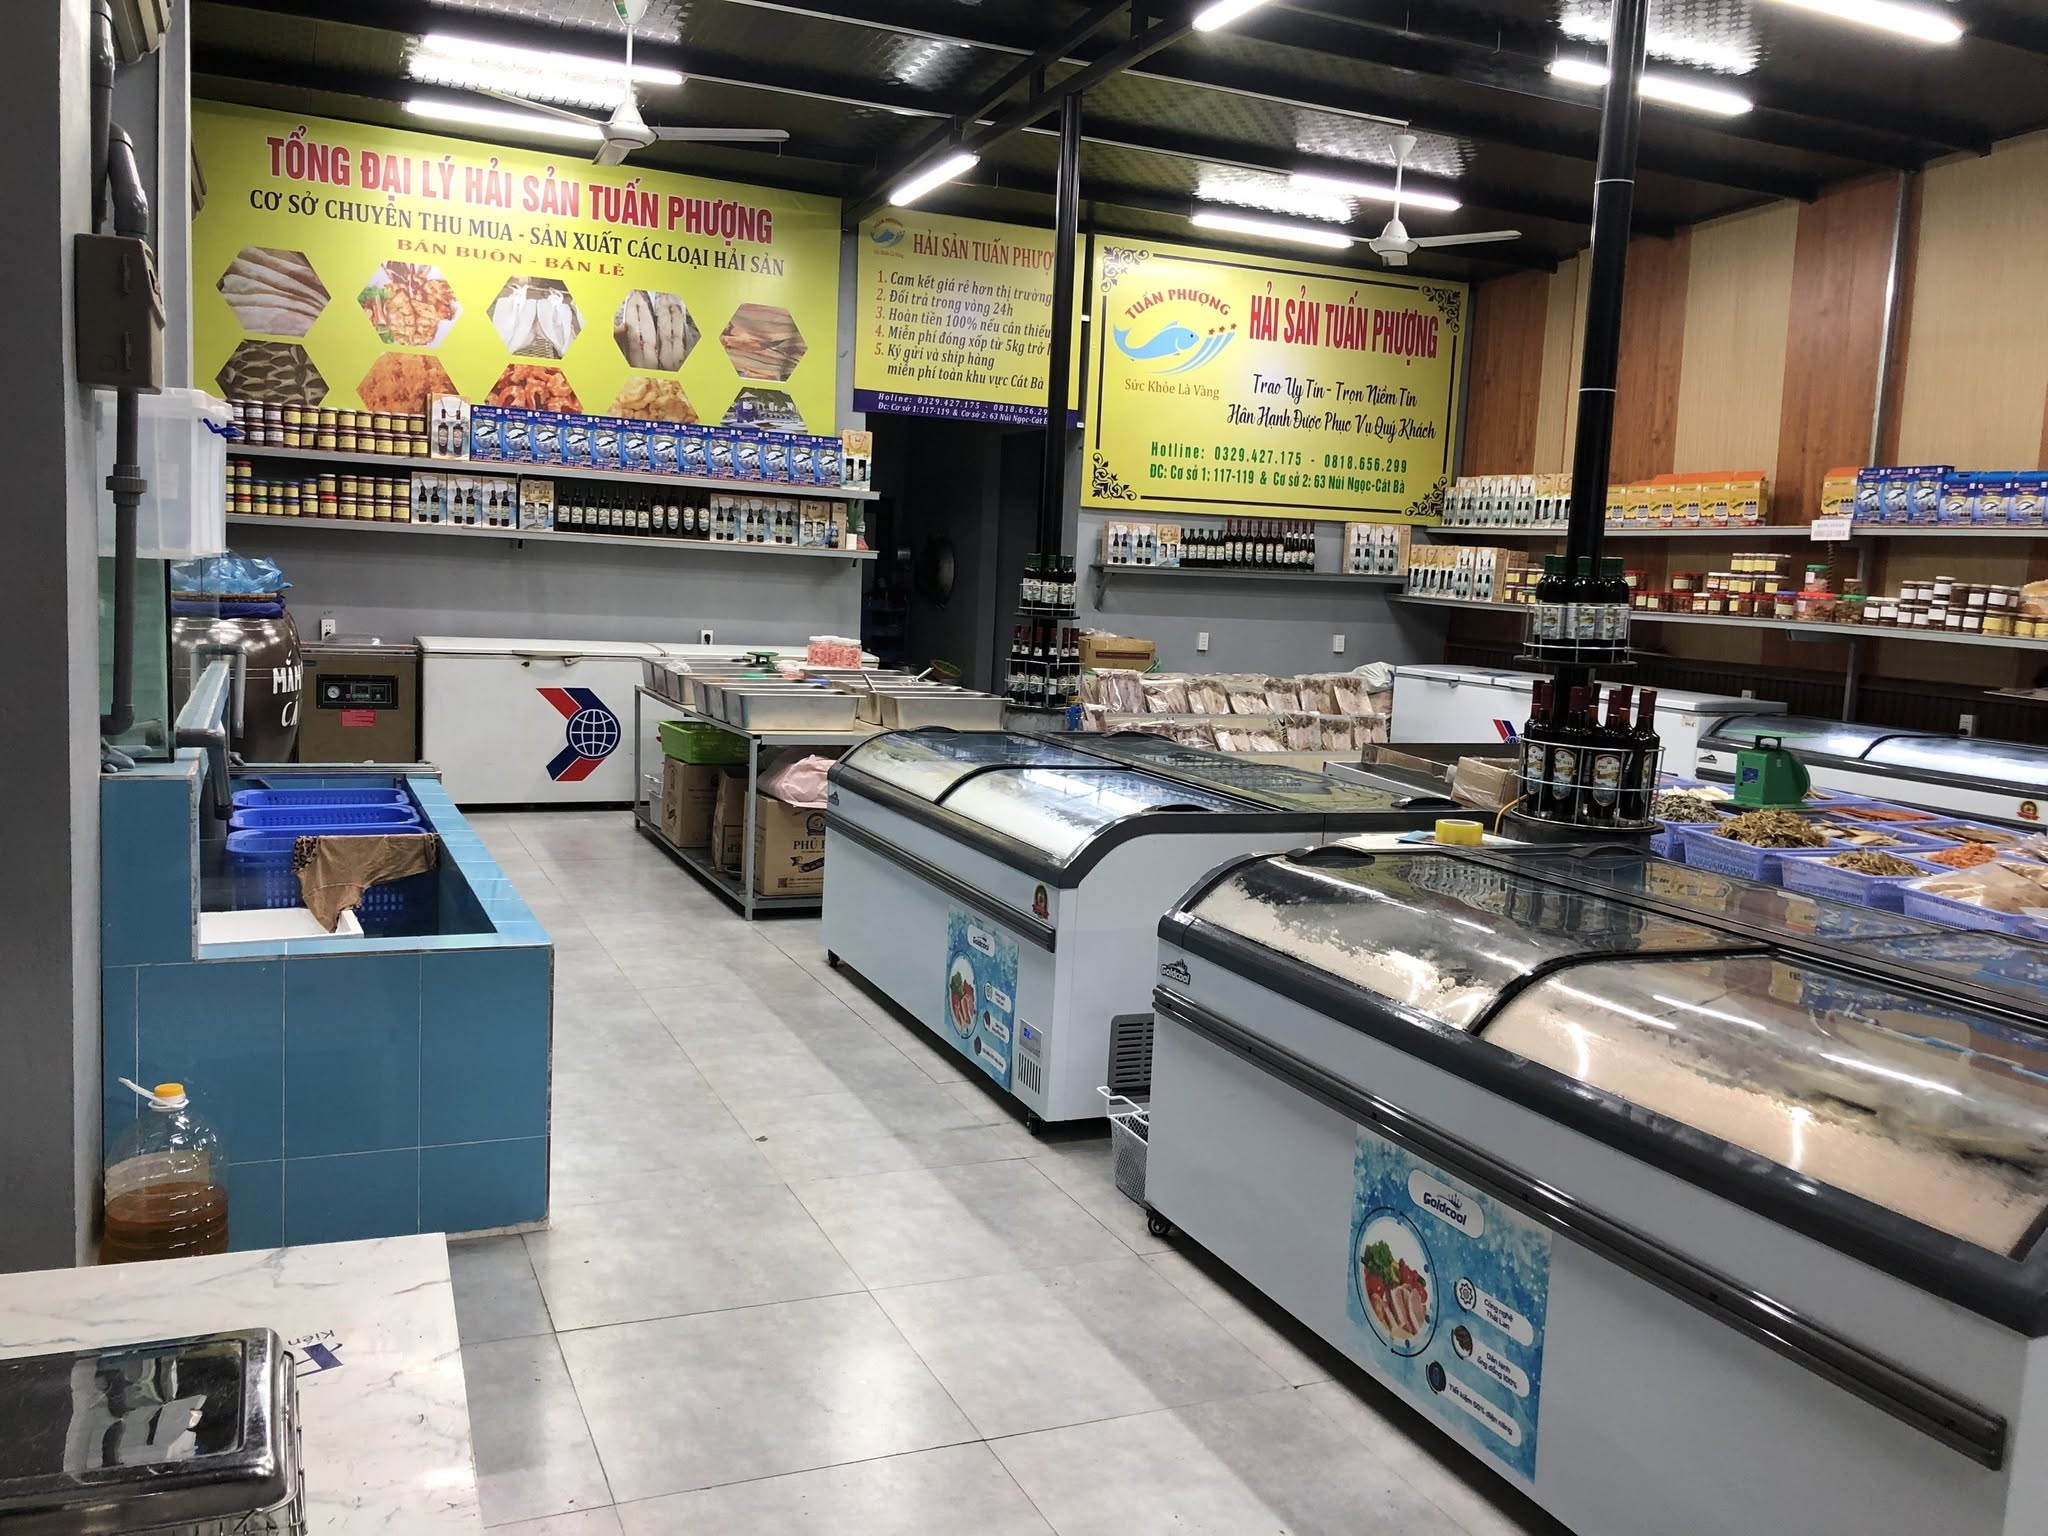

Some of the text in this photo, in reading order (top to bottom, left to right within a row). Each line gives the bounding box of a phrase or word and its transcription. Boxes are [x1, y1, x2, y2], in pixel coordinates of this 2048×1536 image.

[267, 125, 773, 247] TỔNG ĐẠI LÝ HẢI SẢN TUẤN PHƯỢNG
[250, 189, 282, 210] CƠ
[288, 191, 319, 215] SỞ
[325, 200, 411, 228] CHUYÊN
[418, 212, 461, 234] THU
[469, 219, 513, 241] MUA
[530, 224, 567, 248] SẢN
[573, 230, 622, 255] XUẤT
[627, 237, 662, 261] CÁC
[667, 245, 708, 269] LOẠI
[714, 248, 745, 271] HẢI
[751, 253, 784, 276] SẢN
[397, 238, 446, 255] BÁN
[456, 246, 522, 264] BUÔN
[545, 257, 591, 272] BÁN
[600, 263, 624, 277] LẺ
[913, 229, 1054, 275] HẢI SẢN TUẤN PHƯỢ
[876, 288, 886, 301] 2.
[931, 296, 961, 314] trong
[964, 299, 991, 317] vòng
[993, 302, 1014, 317] 24h
[878, 270, 1053, 307] 1. Cam kết giá rẻ hơn thị trường
[1125, 288, 1231, 320] TUẤN PHƯỢNG
[875, 306, 885, 319] 3.
[889, 307, 918, 323] Hoàn
[946, 314, 978, 331] 100%
[980, 318, 1000, 333] nếu
[1024, 323, 1052, 338] thiếu
[1249, 281, 1439, 366] HẢI SẢN TUẤN PHƯỢNG
[875, 324, 885, 337] 4.
[888, 325, 915, 341] Miễn
[918, 329, 937, 345] phí
[939, 331, 966, 350] đóng
[968, 334, 988, 352] xốp
[990, 337, 1003, 350] từ
[1005, 339, 1025, 356] 5kg
[1027, 342, 1045, 355] trở
[874, 343, 995, 371] 5. Ký gửi và ship hàng
[917, 365, 937, 381] phí
[939, 367, 963, 382] toàn
[966, 370, 986, 384] khu
[989, 374, 1008, 388] vực
[1011, 374, 1028, 388] Cát
[1030, 376, 1044, 390] Bà
[1125, 378, 1220, 400] Sức Khỏe Là Vàng
[1253, 374, 1281, 396] Trao
[1285, 377, 1303, 405] Uy
[1306, 378, 1325, 399] Tín
[1336, 381, 1363, 405] Trọn
[1366, 384, 1397, 406] Niềm
[918, 396, 981, 410] 0329.427.175
[993, 404, 1048, 415] 0818.656.29
[921, 406, 950, 416] 117-119
[952, 409, 958, 417] &
[989, 413, 999, 421] 63
[1227, 403, 1436, 444] Hân Hạnh Được Phục Vụ Quý Khách
[1151, 441, 1205, 460] Hotline:
[1214, 446, 1302, 466] 0329.427.175
[1324, 453, 1408, 474] 0818.656.299
[1150, 463, 1405, 495] ĐC: Cơ sở 1: 117-119 & Cơ sở 2: 63 Núi Ngọc-Cát Bà
[1161, 964, 1191, 985] Goldcool
[1423, 1191, 1467, 1226] Goldcool
